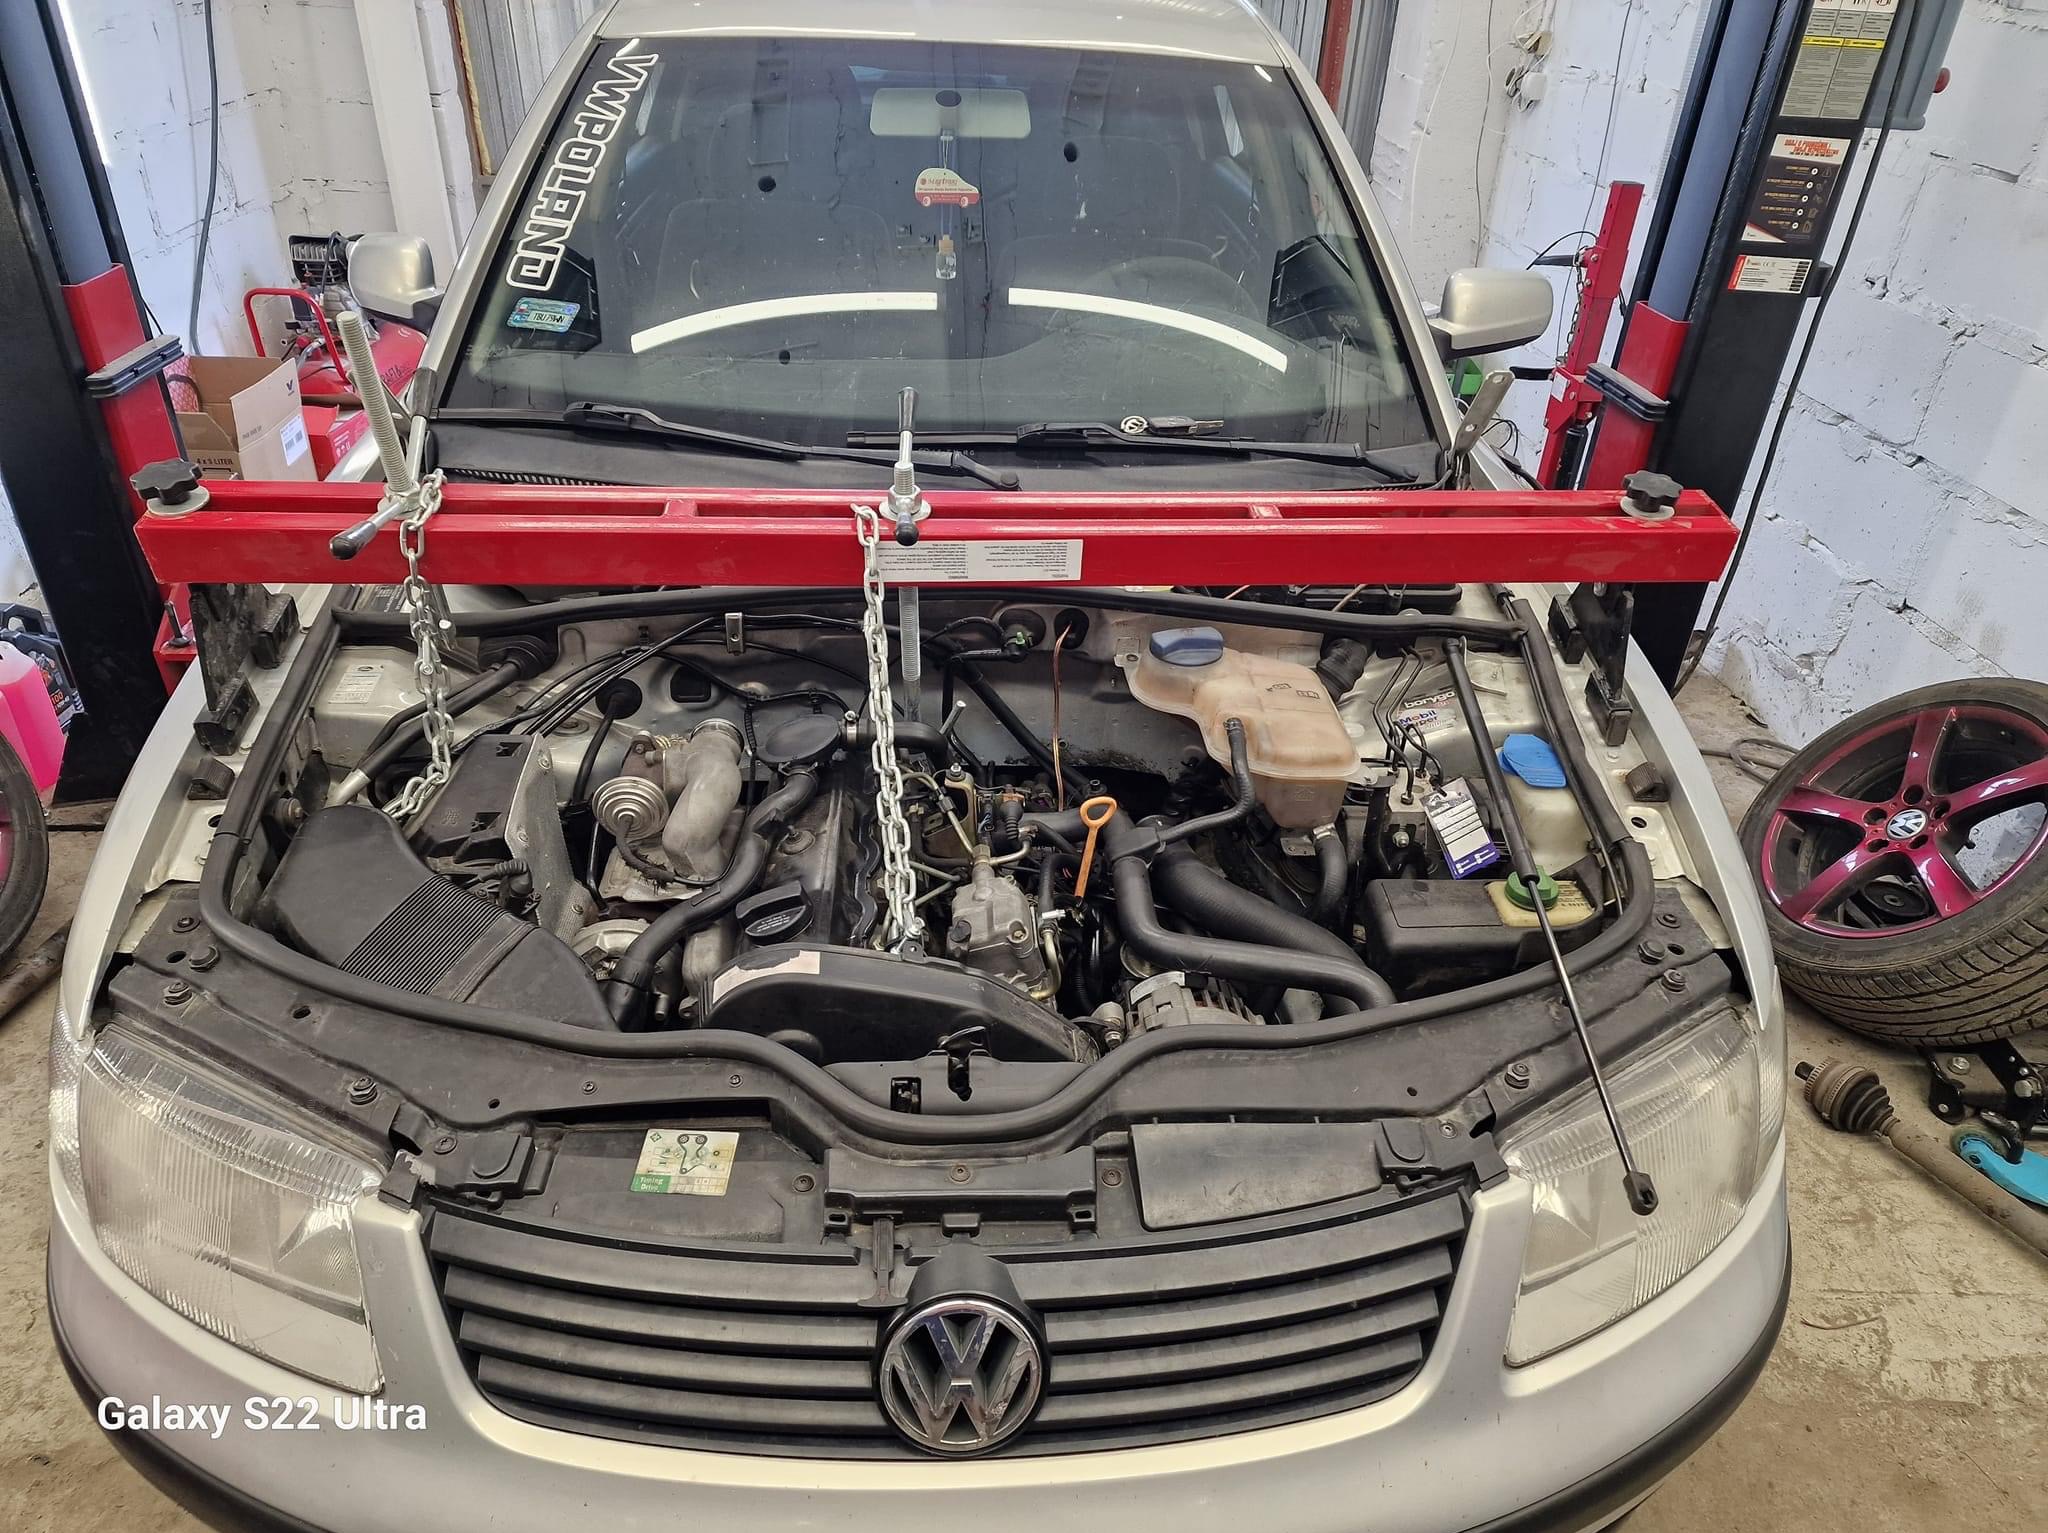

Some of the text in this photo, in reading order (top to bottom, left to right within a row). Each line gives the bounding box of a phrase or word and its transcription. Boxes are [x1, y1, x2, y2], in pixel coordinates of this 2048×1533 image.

[506, 53, 659, 291] VWPOLAND
[213, 457, 234, 466] LITER
[1404, 690, 1456, 709] borygo
[1399, 709, 1438, 725] Mobil
